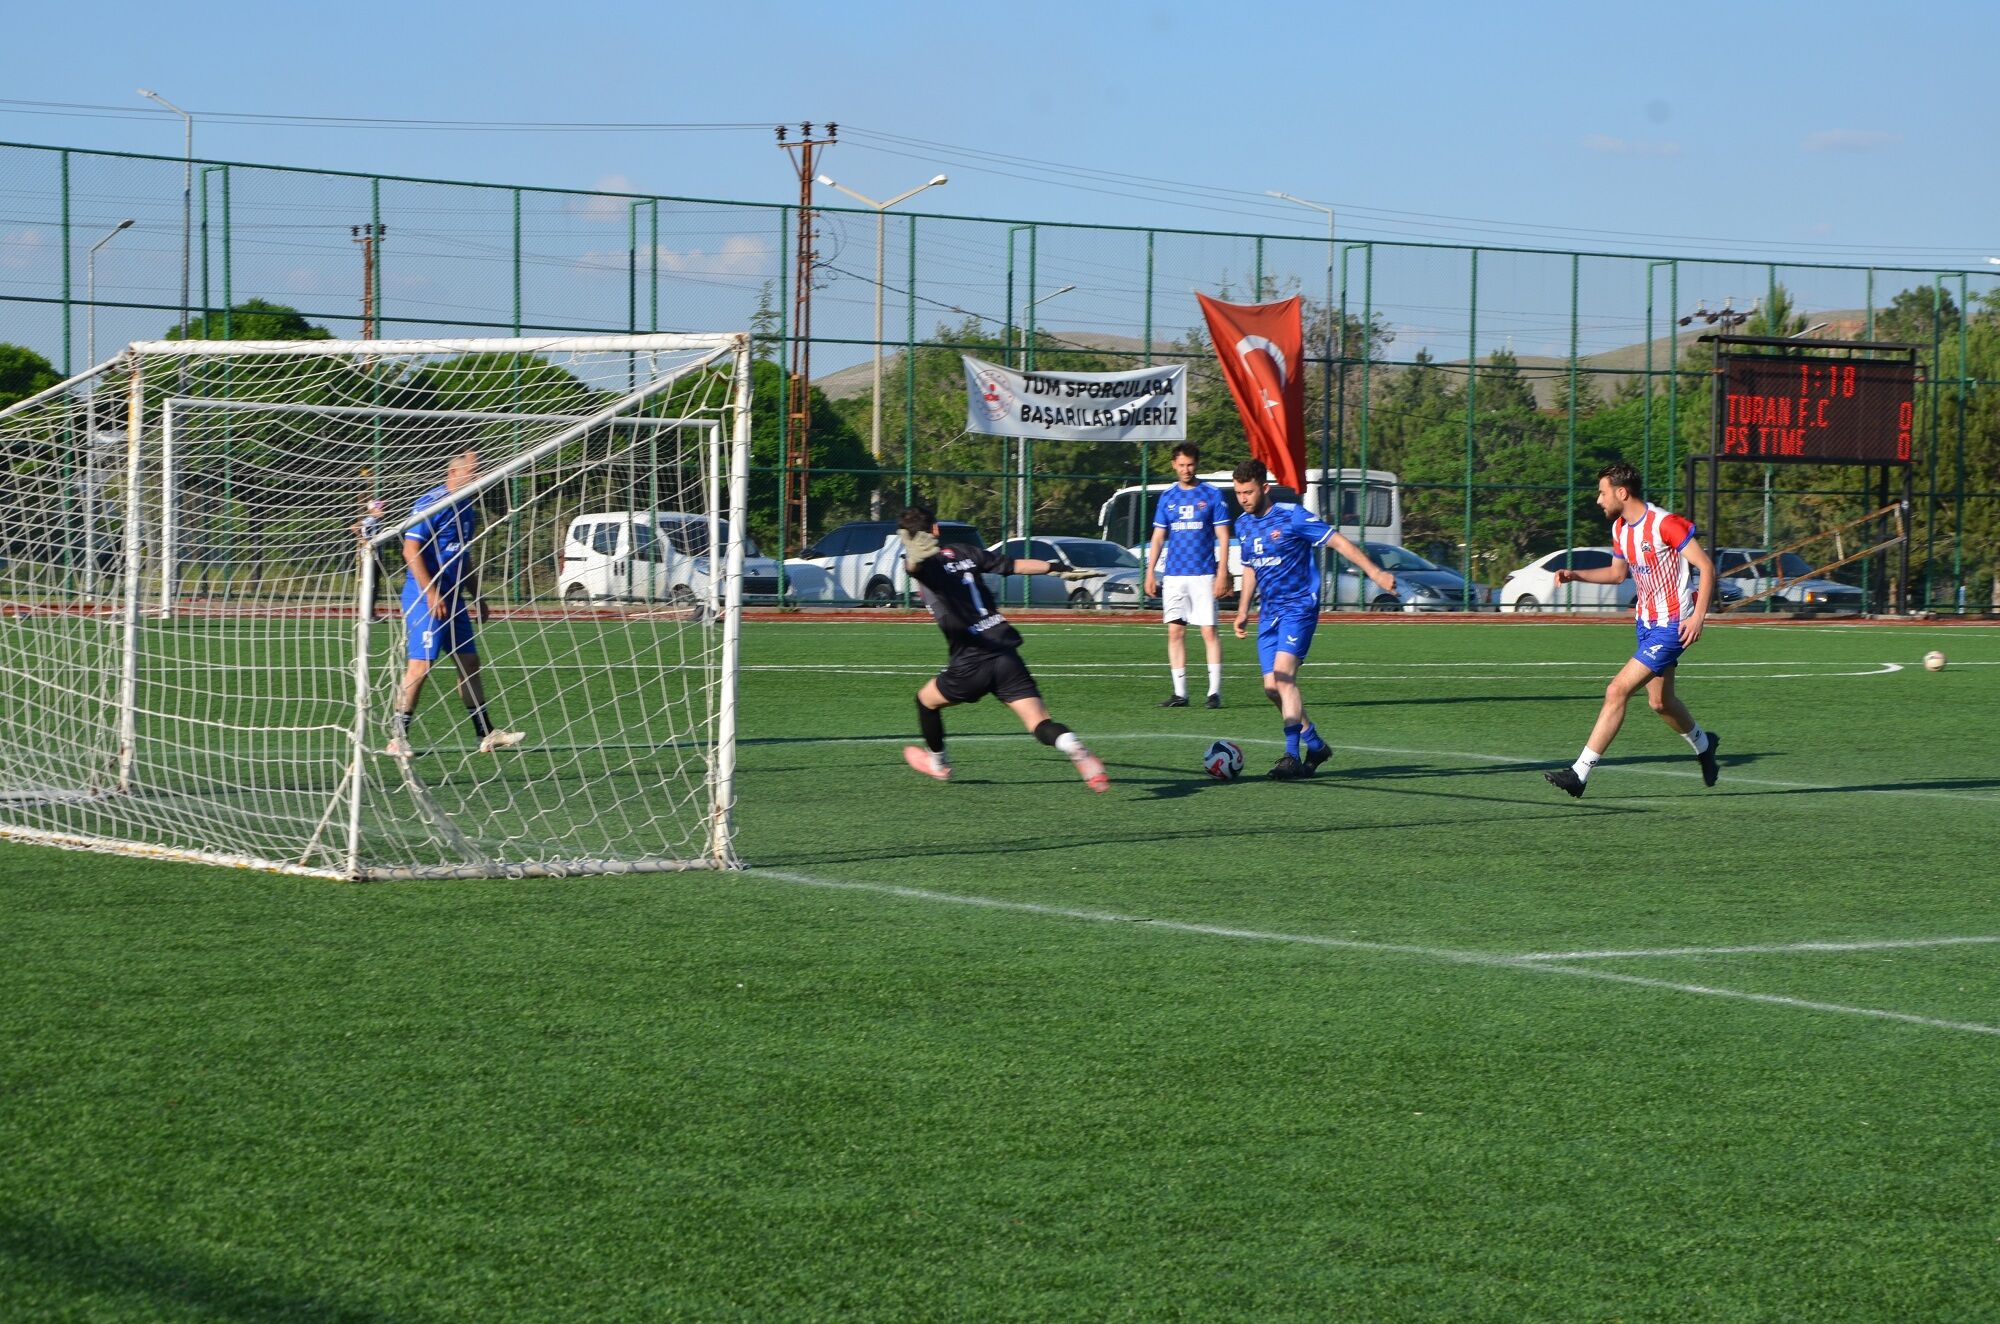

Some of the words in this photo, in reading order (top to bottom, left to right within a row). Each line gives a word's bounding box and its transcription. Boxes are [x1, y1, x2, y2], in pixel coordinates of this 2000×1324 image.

[1065, 378, 1175, 399] SPORCULARA
[1800, 363, 1857, 399] 1:18
[1021, 404, 1115, 430] BAŞARILAR
[1118, 401, 1178, 426] DİLERİZ
[1727, 394, 1792, 427] TURAN
[1798, 397, 1831, 429] F.C
[1899, 401, 1913, 431] 0
[1724, 426, 1749, 455] PS
[1897, 431, 1912, 461] 0
[1253, 537, 1264, 555] 6
[961, 571, 988, 617] 1
[1649, 644, 1664, 655] 4
